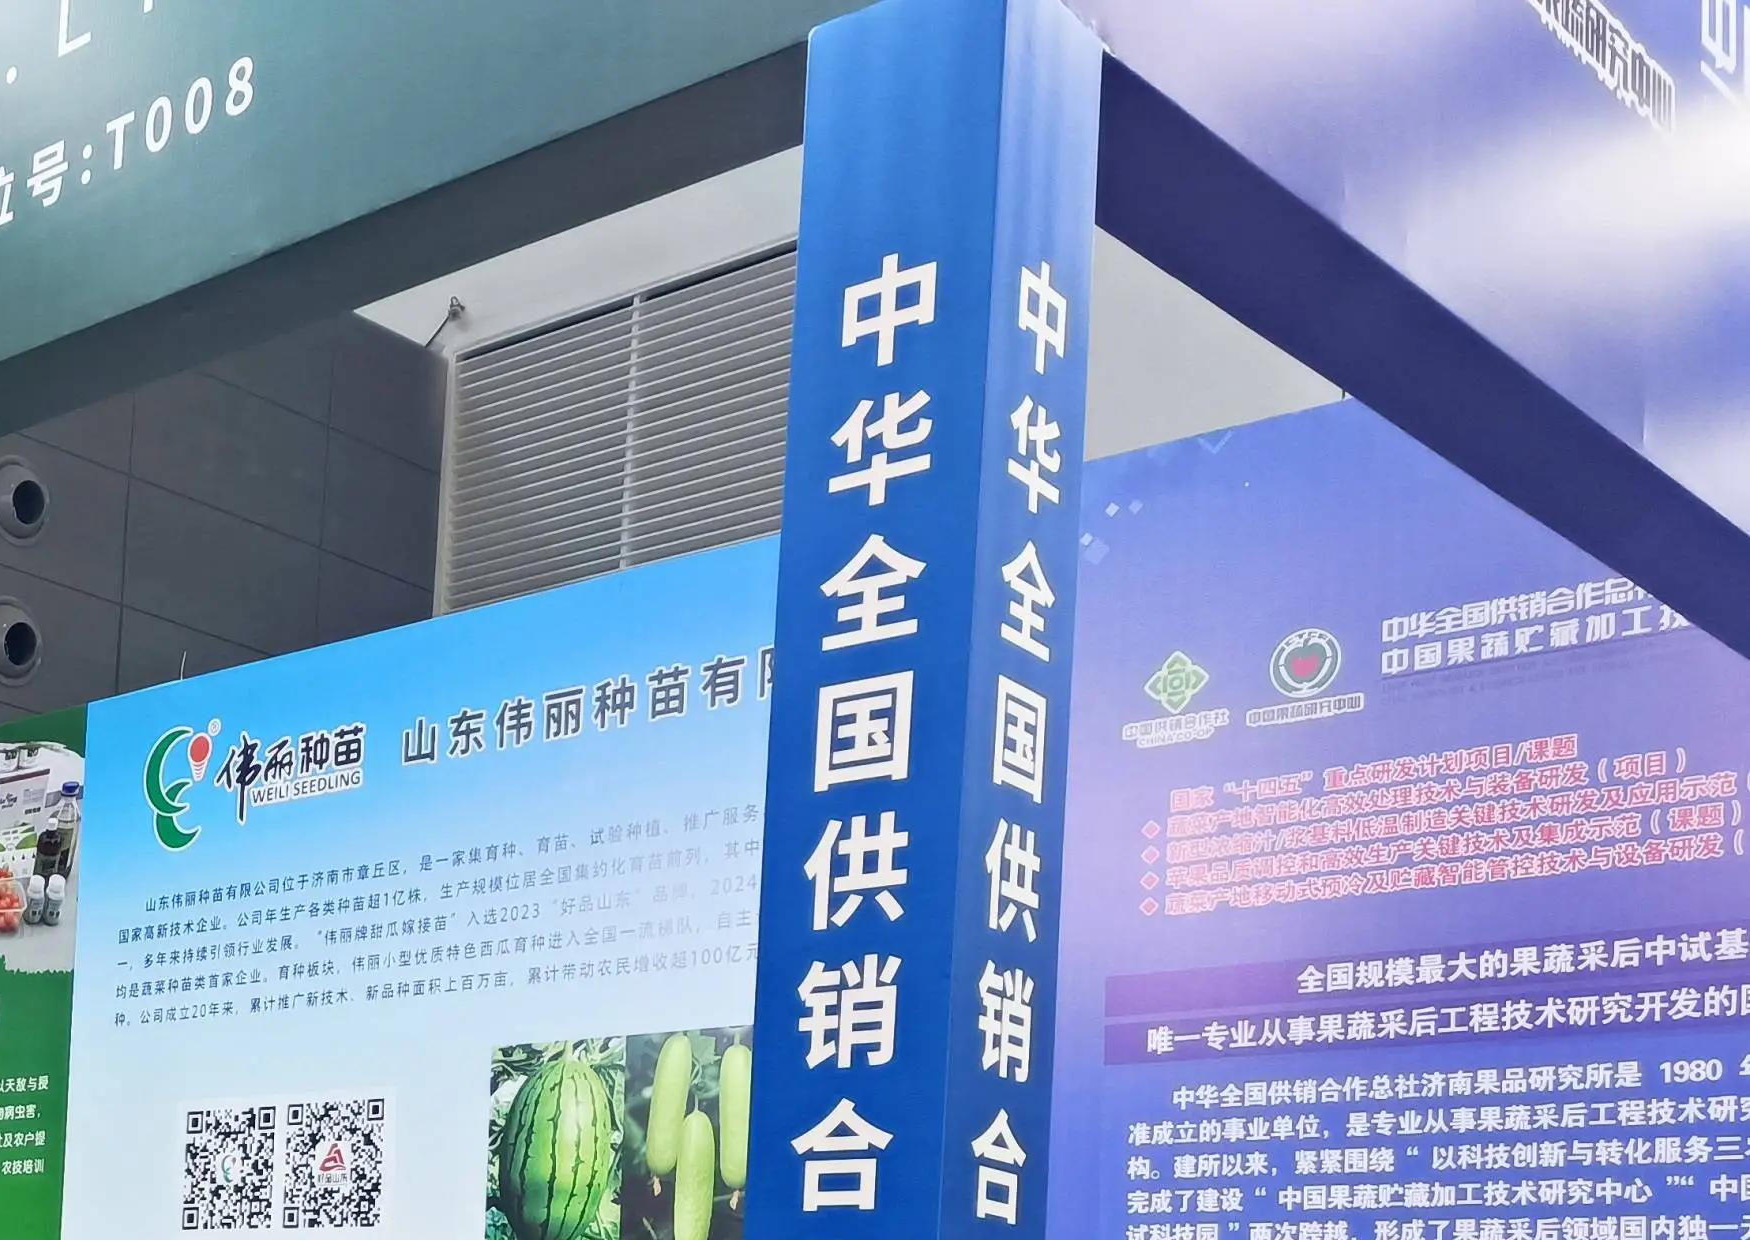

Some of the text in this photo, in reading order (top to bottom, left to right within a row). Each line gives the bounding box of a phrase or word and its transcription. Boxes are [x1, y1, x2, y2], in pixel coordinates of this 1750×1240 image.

[216, 723, 367, 822] 伟丽种苗
[252, 769, 362, 808] WEILI SEEDLING
[1296, 927, 1749, 996] 全国规模最大的果蔬采后中试基
[1147, 984, 1750, 1056] 唯一专业从事果蔬采后工程技术研究开发的
[1172, 1058, 1723, 1111] 中华全国供销合作总社济南果品研究所是 1980
[1127, 1136, 1750, 1181] 构。建所以来，紧紧围绕“以科技创新与转化服务三
